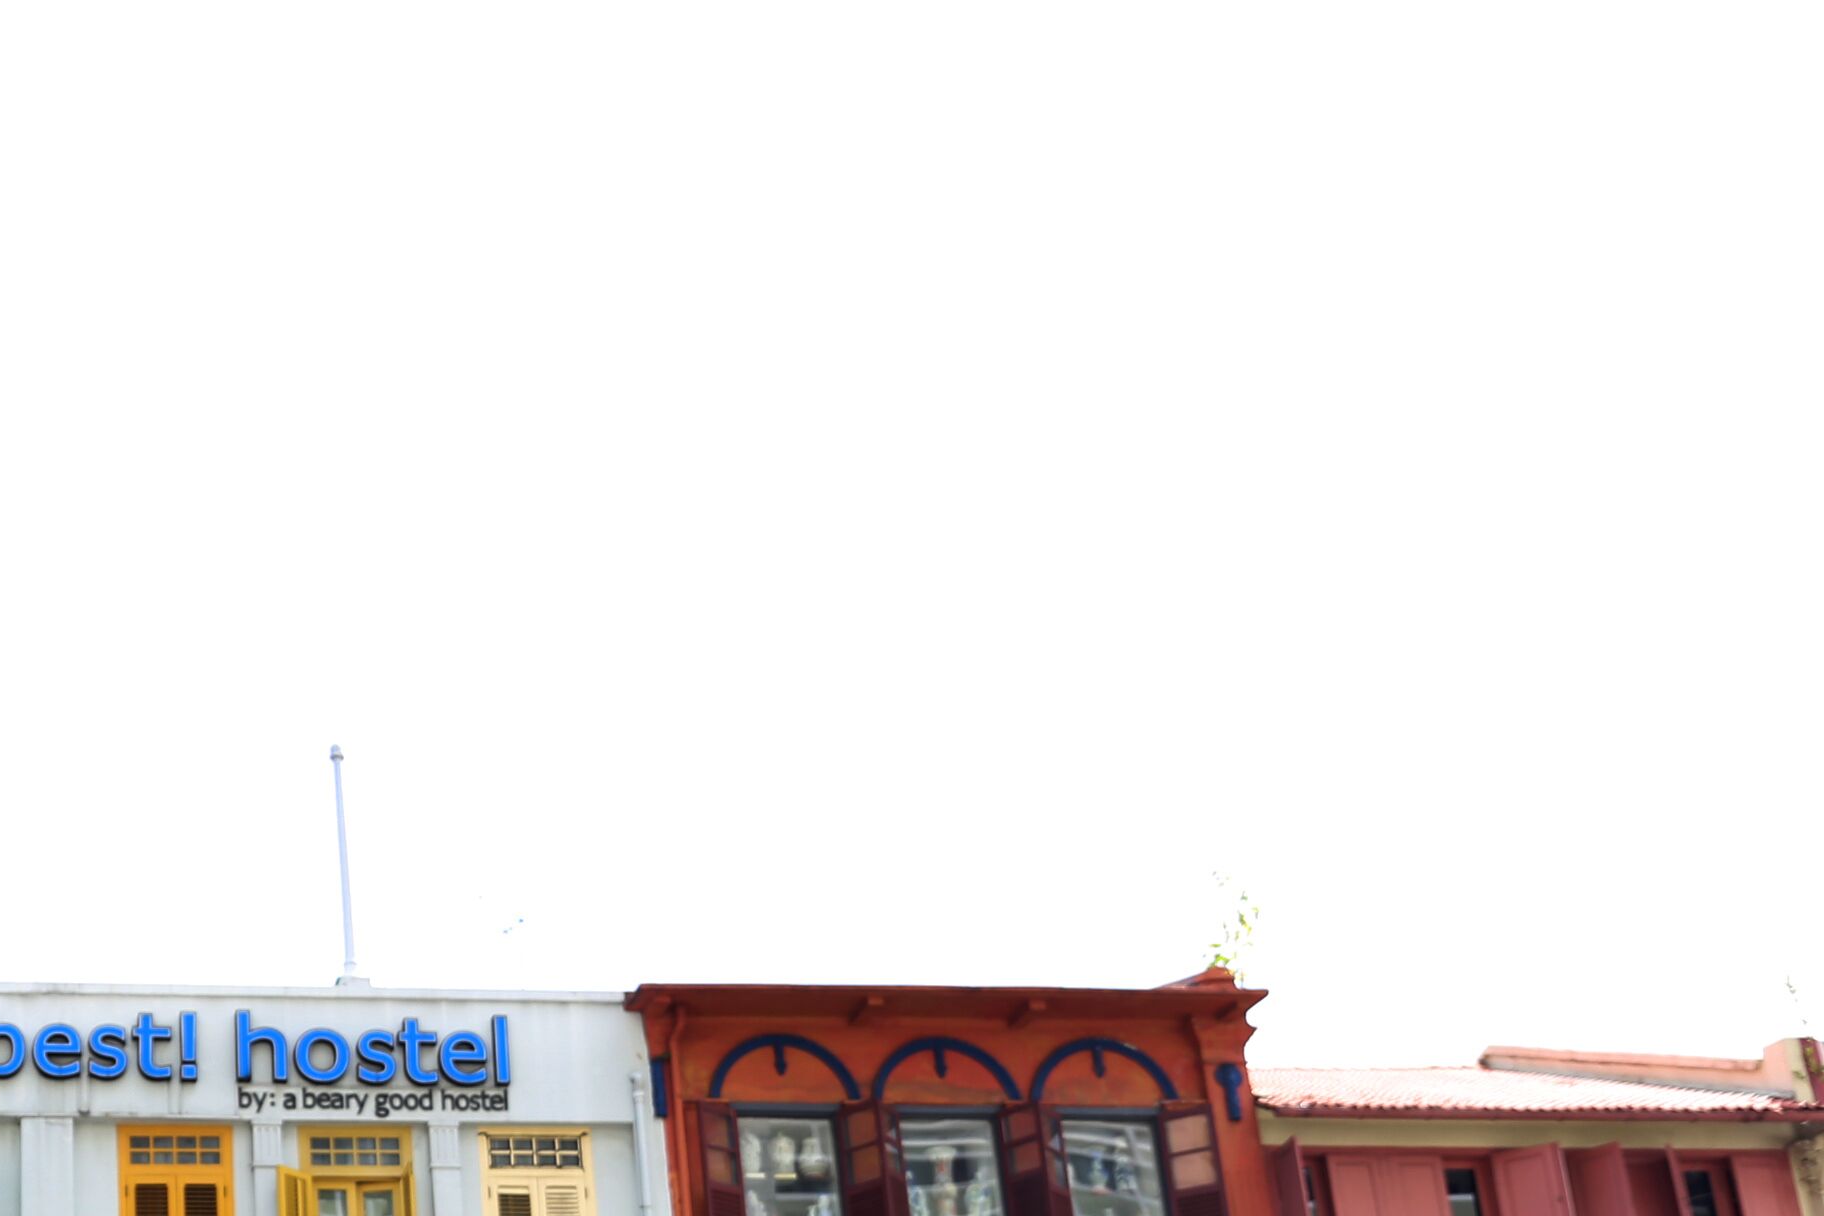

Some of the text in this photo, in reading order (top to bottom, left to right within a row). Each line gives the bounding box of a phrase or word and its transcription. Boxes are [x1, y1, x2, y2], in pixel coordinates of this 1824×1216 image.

[234, 1009, 510, 1086] hostel
[238, 1088, 509, 1117] by: a beary good hostel
